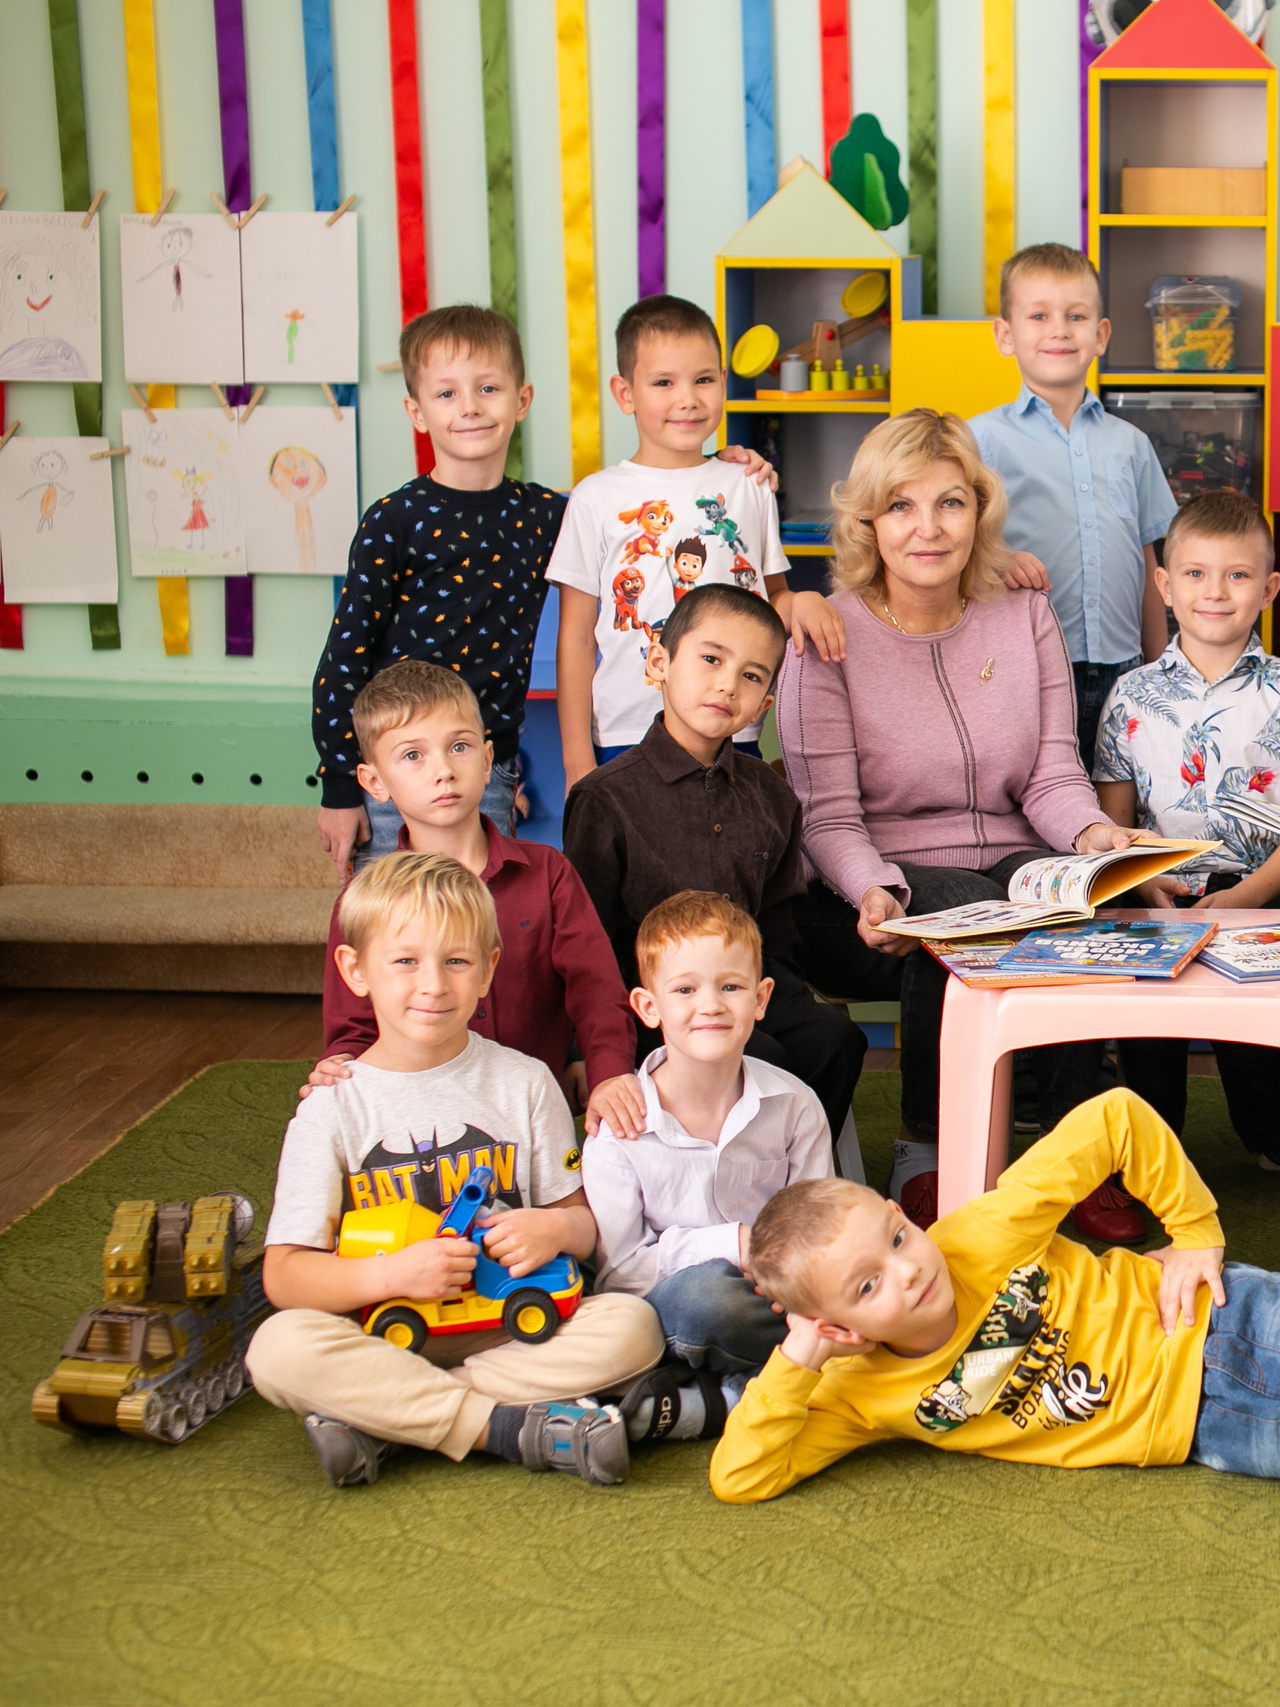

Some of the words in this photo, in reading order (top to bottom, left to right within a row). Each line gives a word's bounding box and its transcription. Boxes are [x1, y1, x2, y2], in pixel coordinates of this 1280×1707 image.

[350, 1160, 421, 1212] BAT
[436, 1140, 519, 1207] MAN
[965, 1363, 998, 1378] RIDE
[966, 1350, 1015, 1367] URBAN
[990, 1322, 1063, 1417] SKATE
